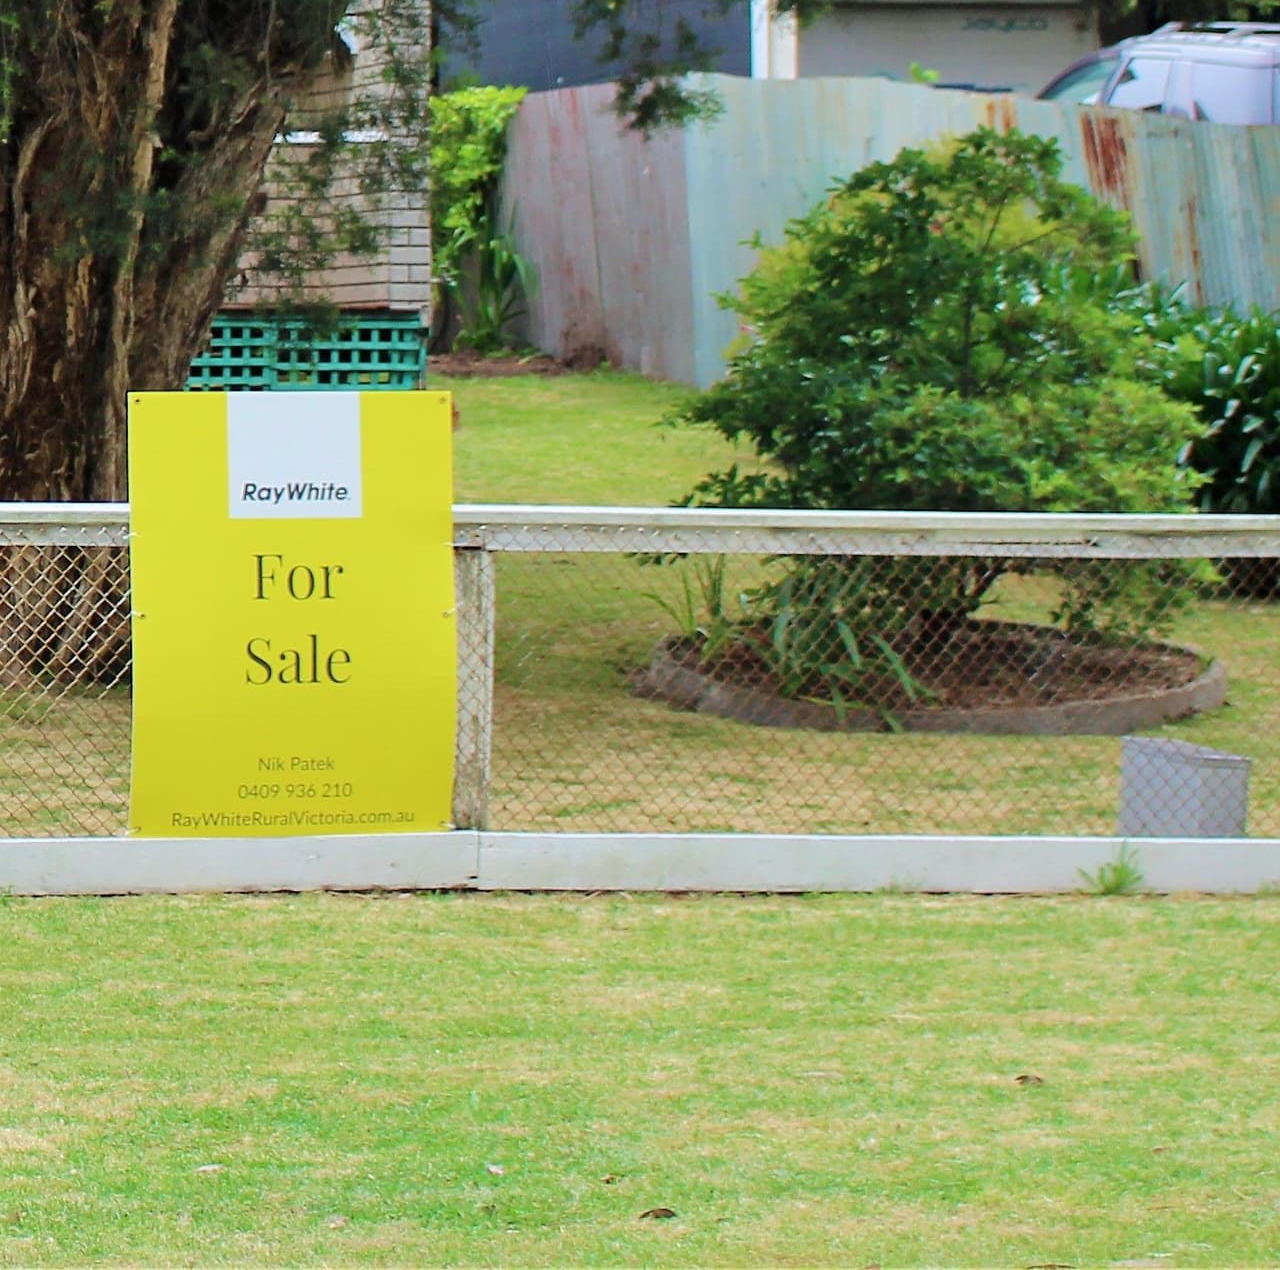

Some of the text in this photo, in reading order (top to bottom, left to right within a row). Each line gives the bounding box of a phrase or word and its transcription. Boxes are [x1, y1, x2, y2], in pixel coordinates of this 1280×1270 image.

[252, 553, 344, 601] For
[245, 634, 352, 686] Sale
[258, 756, 335, 771] Nik Patek
[238, 782, 353, 799] 0409 936 210
[172, 810, 416, 829] RayWhiteRuralVictoria.com.au
